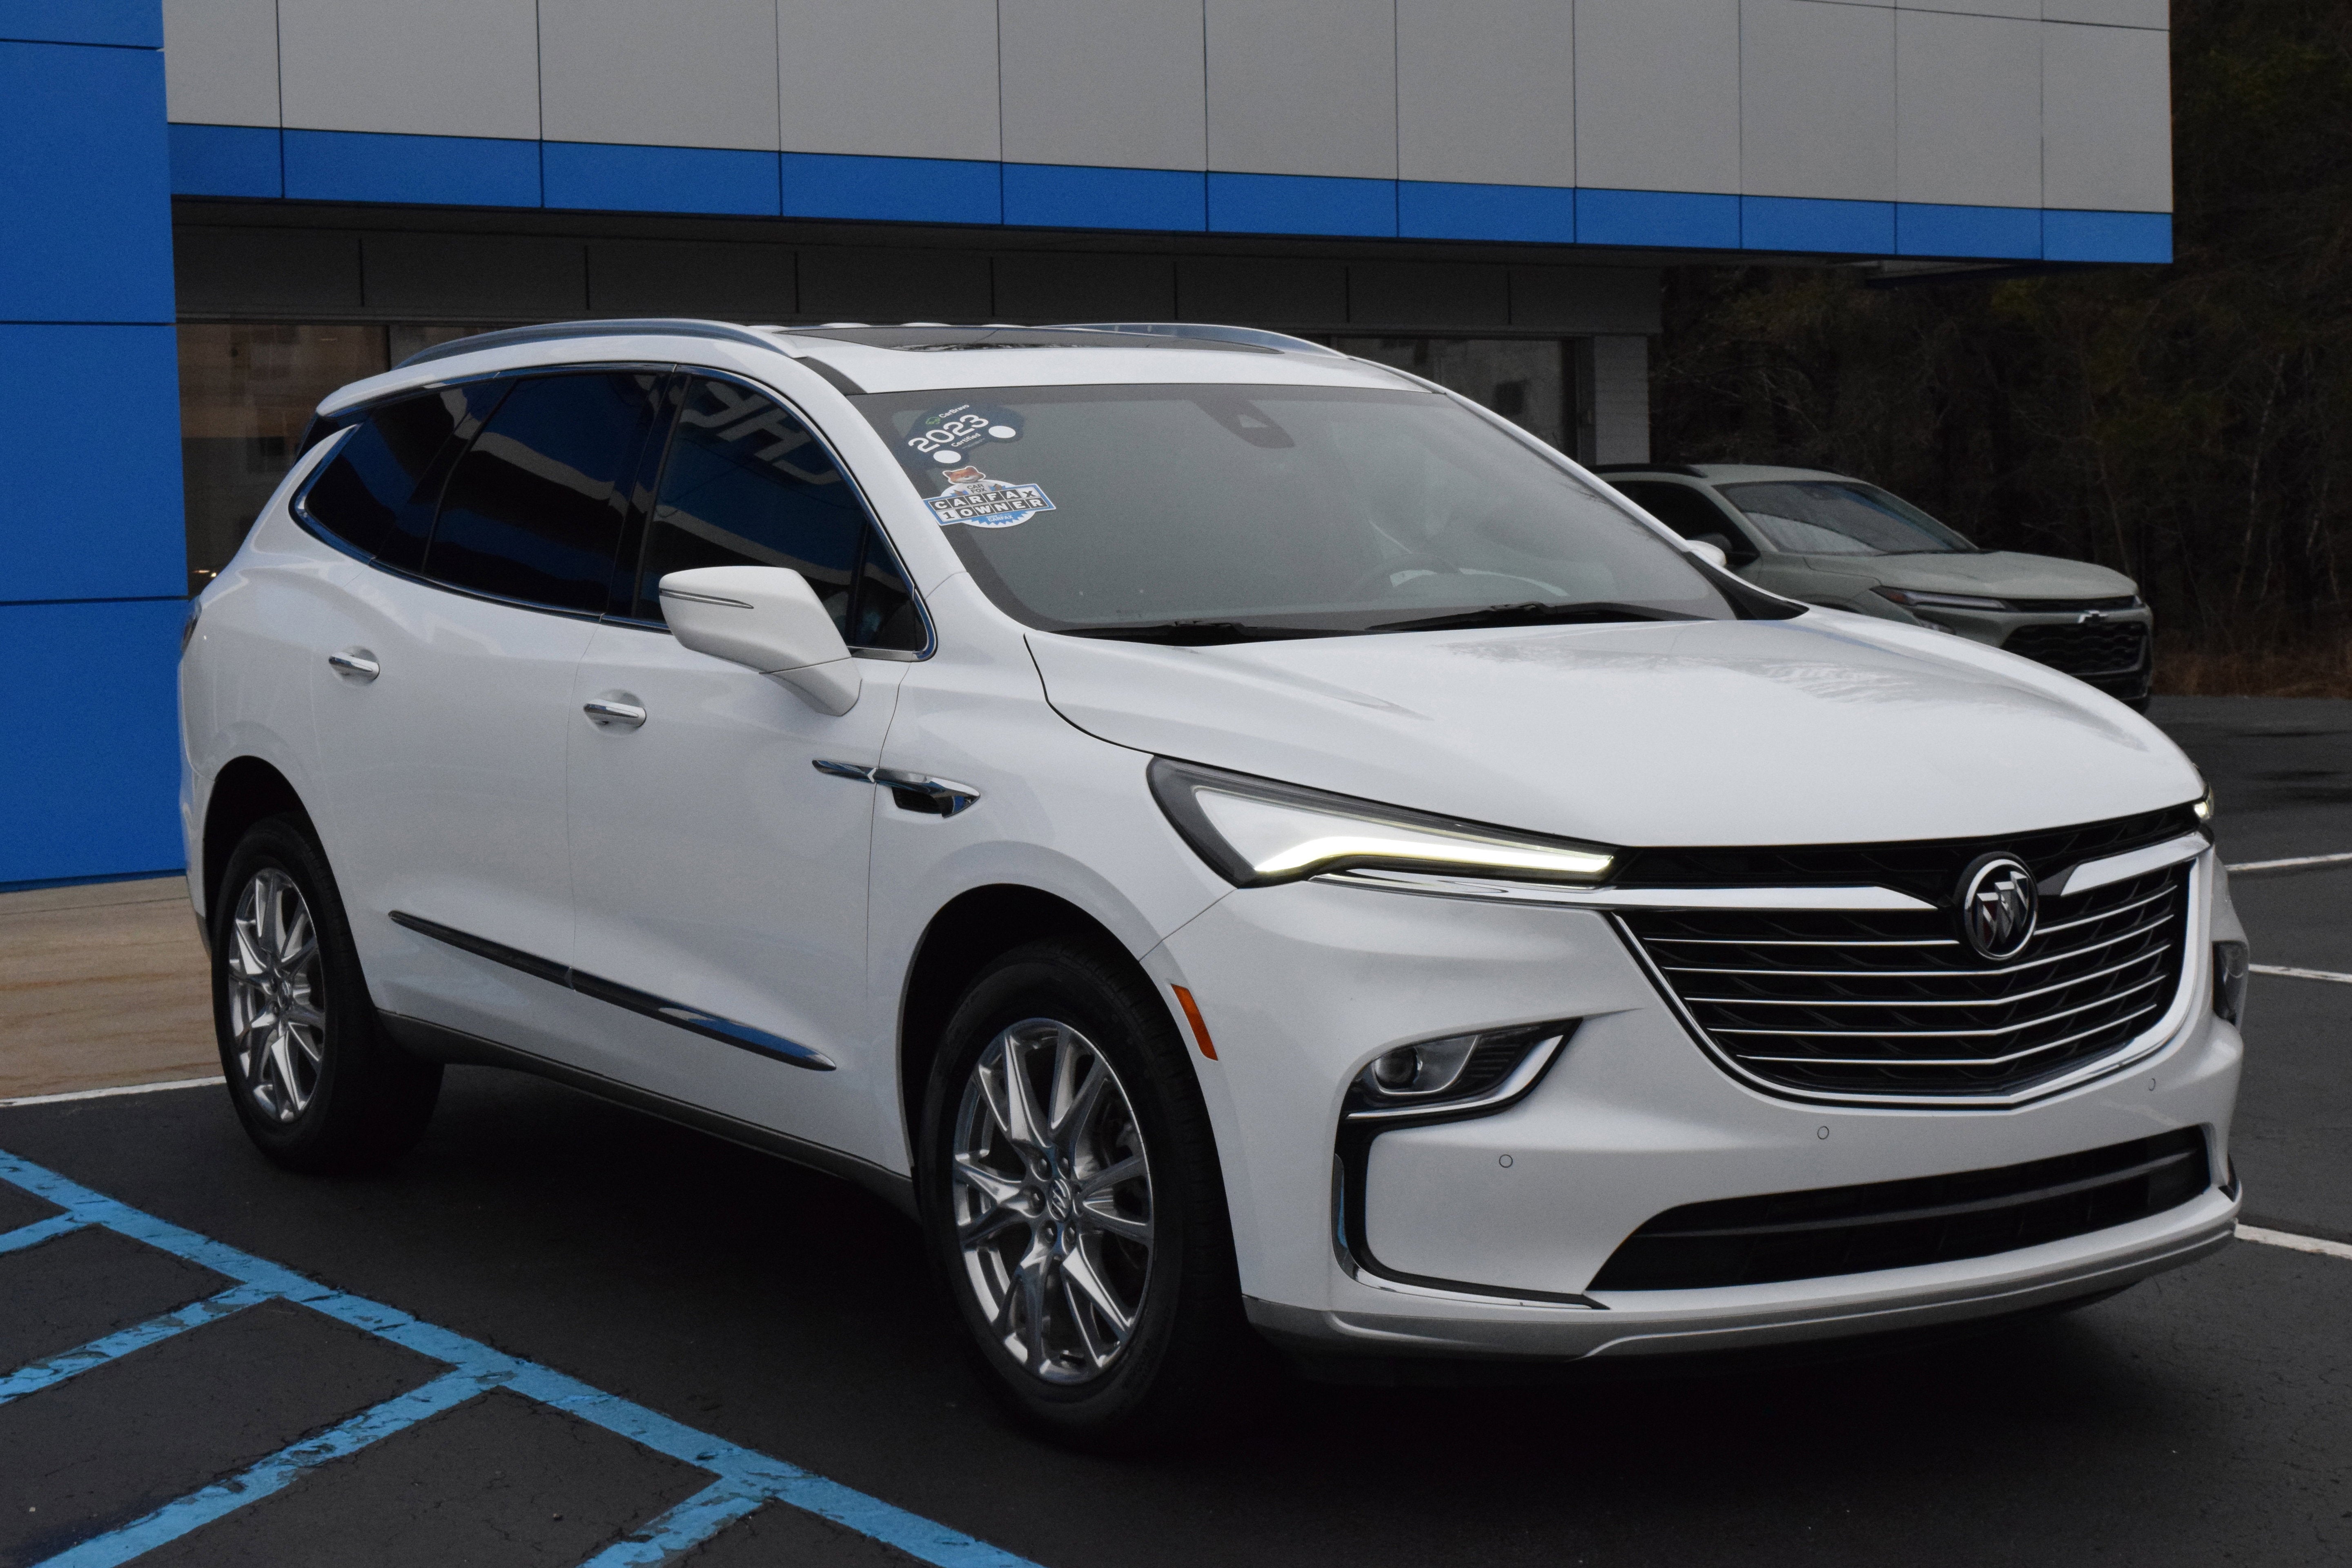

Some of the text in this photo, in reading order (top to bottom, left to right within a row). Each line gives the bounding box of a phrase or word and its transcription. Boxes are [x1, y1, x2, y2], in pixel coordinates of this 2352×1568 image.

[939, 404, 969, 418] CarBravo
[908, 414, 989, 452] 2023
[951, 433, 981, 447] Certified
[935, 490, 1036, 509] CARFAX
[942, 499, 1044, 520] 1 OWNER
